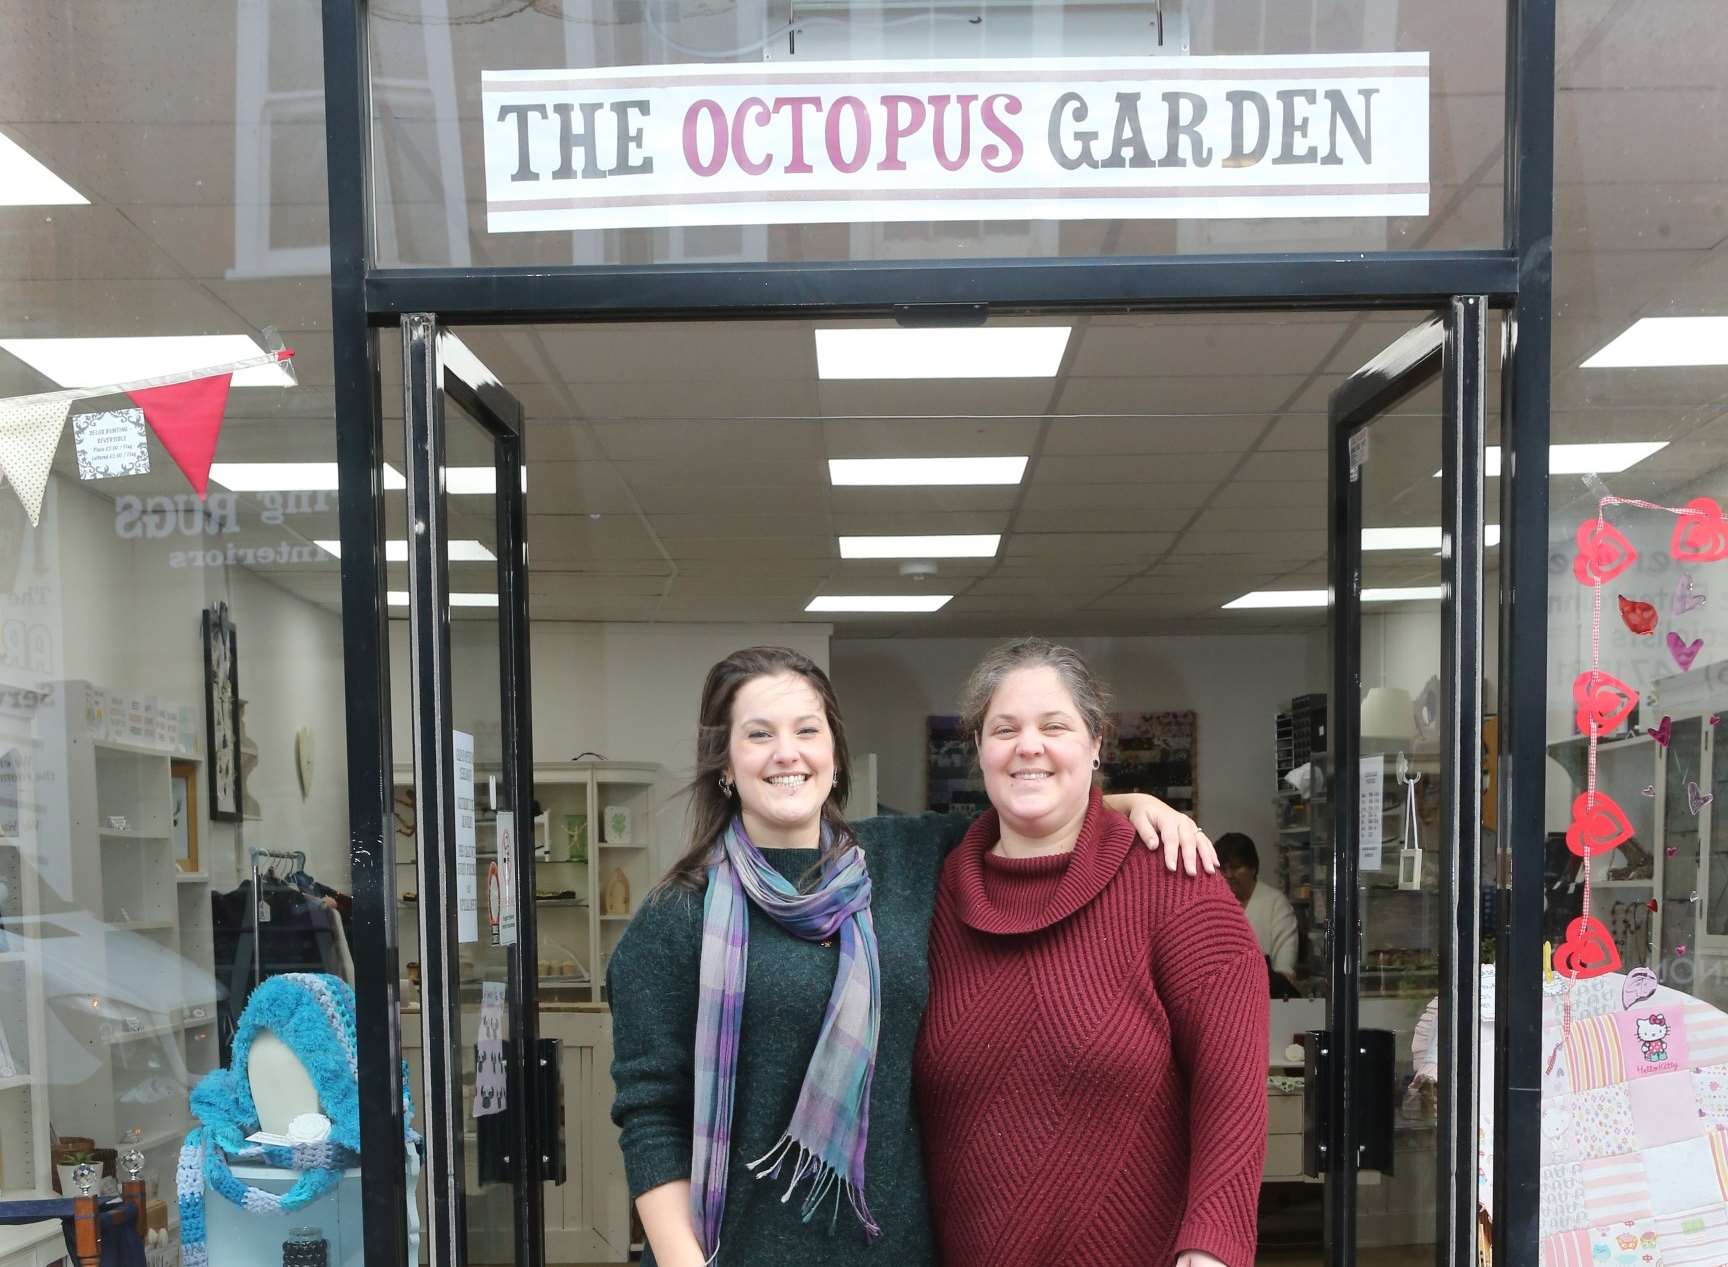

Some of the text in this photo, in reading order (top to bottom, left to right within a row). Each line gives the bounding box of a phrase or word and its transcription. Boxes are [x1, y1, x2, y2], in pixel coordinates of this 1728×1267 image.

[498, 89, 1380, 181] THE OCTOPUS GARDEN
